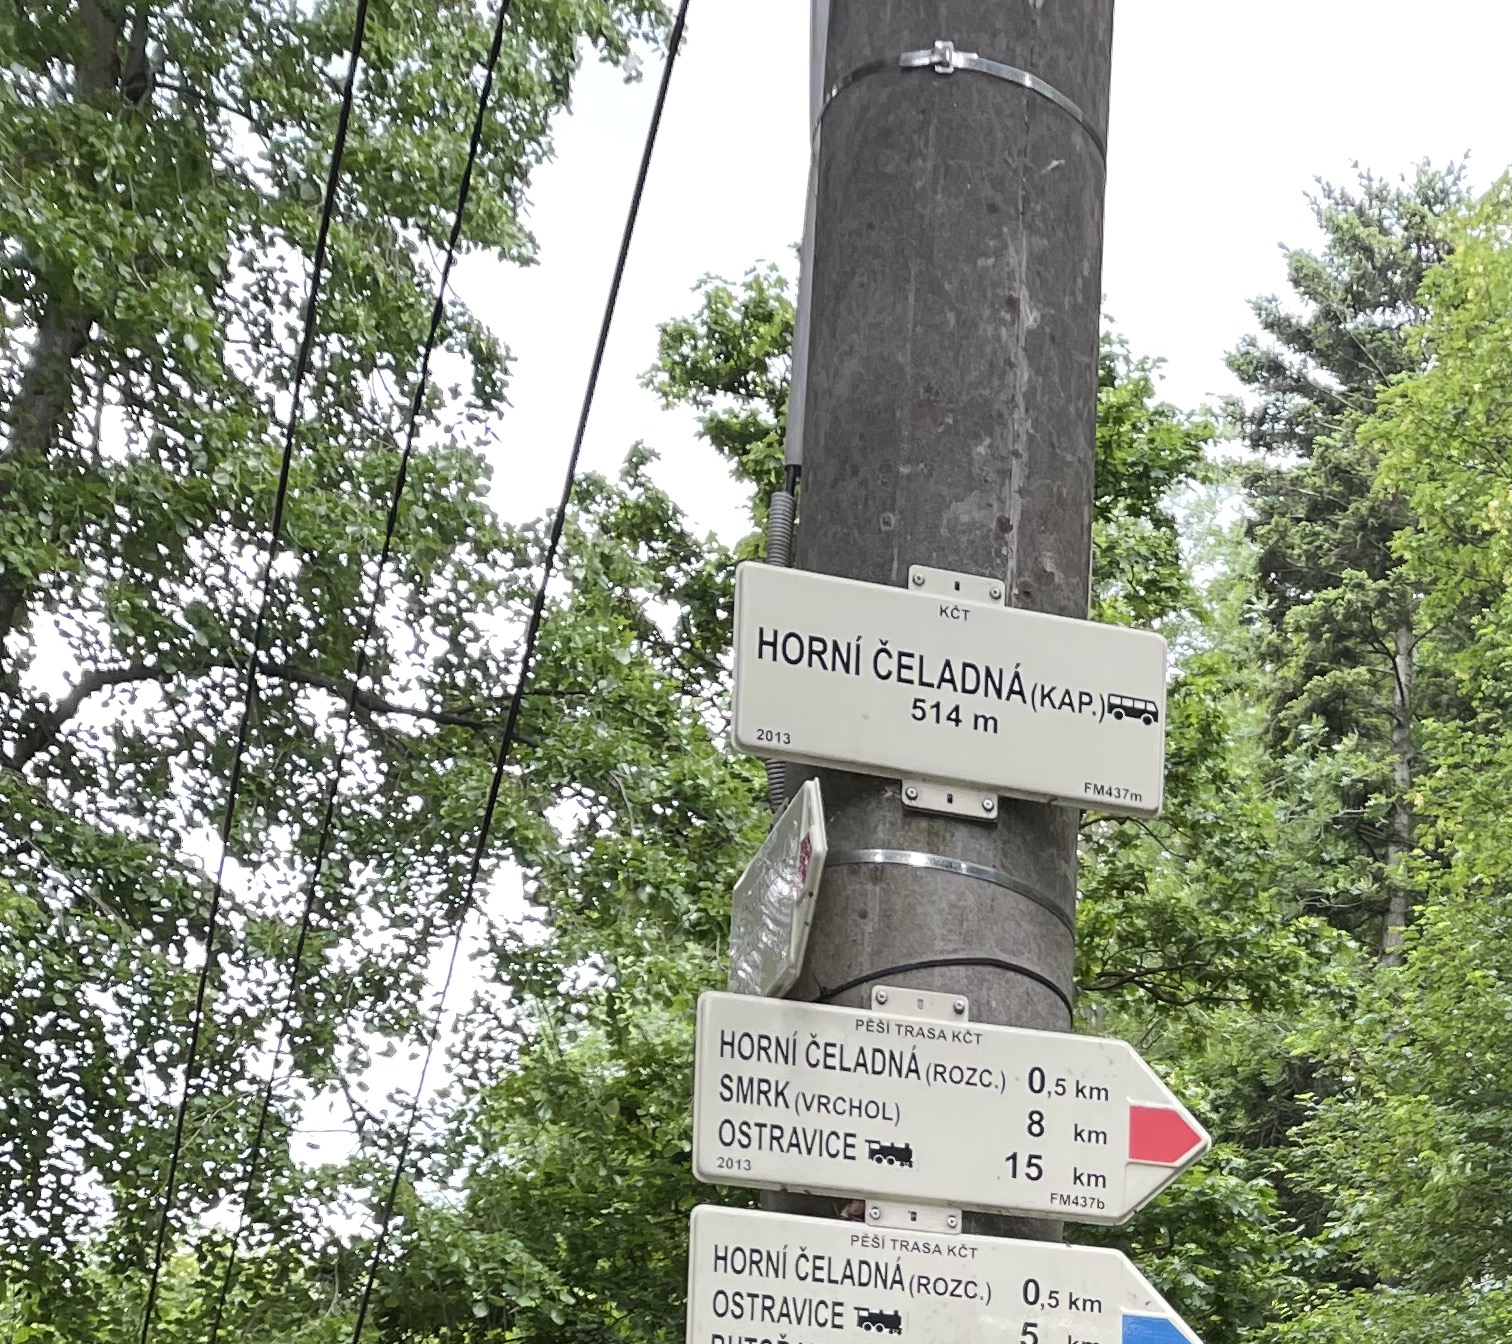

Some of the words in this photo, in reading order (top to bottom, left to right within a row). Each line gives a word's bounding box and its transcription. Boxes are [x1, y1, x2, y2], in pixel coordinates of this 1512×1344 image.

[940, 605, 970, 621] KČT
[758, 627, 862, 675] HORNÍ
[873, 639, 1026, 704] ČELADNÁ
[912, 698, 962, 727] 514
[974, 714, 997, 733] m
[757, 729, 790, 744] 2013
[1085, 782, 1142, 802] FM437m
[856, 1018, 889, 1034] PĚŠÍ
[895, 1024, 947, 1041] TRASA
[952, 1030, 982, 1045] KČT
[720, 1030, 797, 1065] HORNÍ
[806, 1033, 921, 1080] ČELADNÁ
[1029, 1067, 1066, 1097] 0,5
[1076, 1080, 1108, 1101] km
[720, 1074, 789, 1108] SMRK
[1028, 1110, 1044, 1137] 8
[1074, 1124, 1106, 1144] km
[717, 1157, 751, 1171] 2013
[719, 1119, 856, 1164] OSTRAVICE
[1006, 1152, 1042, 1181] 15
[1073, 1167, 1106, 1188] km
[1050, 1193, 1105, 1209] FM437b
[851, 1233, 884, 1249] PĚŠÍ
[890, 1239, 942, 1255] TRASA
[947, 1244, 978, 1258] KČT
[714, 1245, 787, 1279] HORNÍ
[795, 1246, 904, 1291] ČELADNÁ
[1023, 1279, 1059, 1310] 0,5
[1069, 1292, 1101, 1313] km
[713, 1290, 844, 1329] OSTRAVICE
